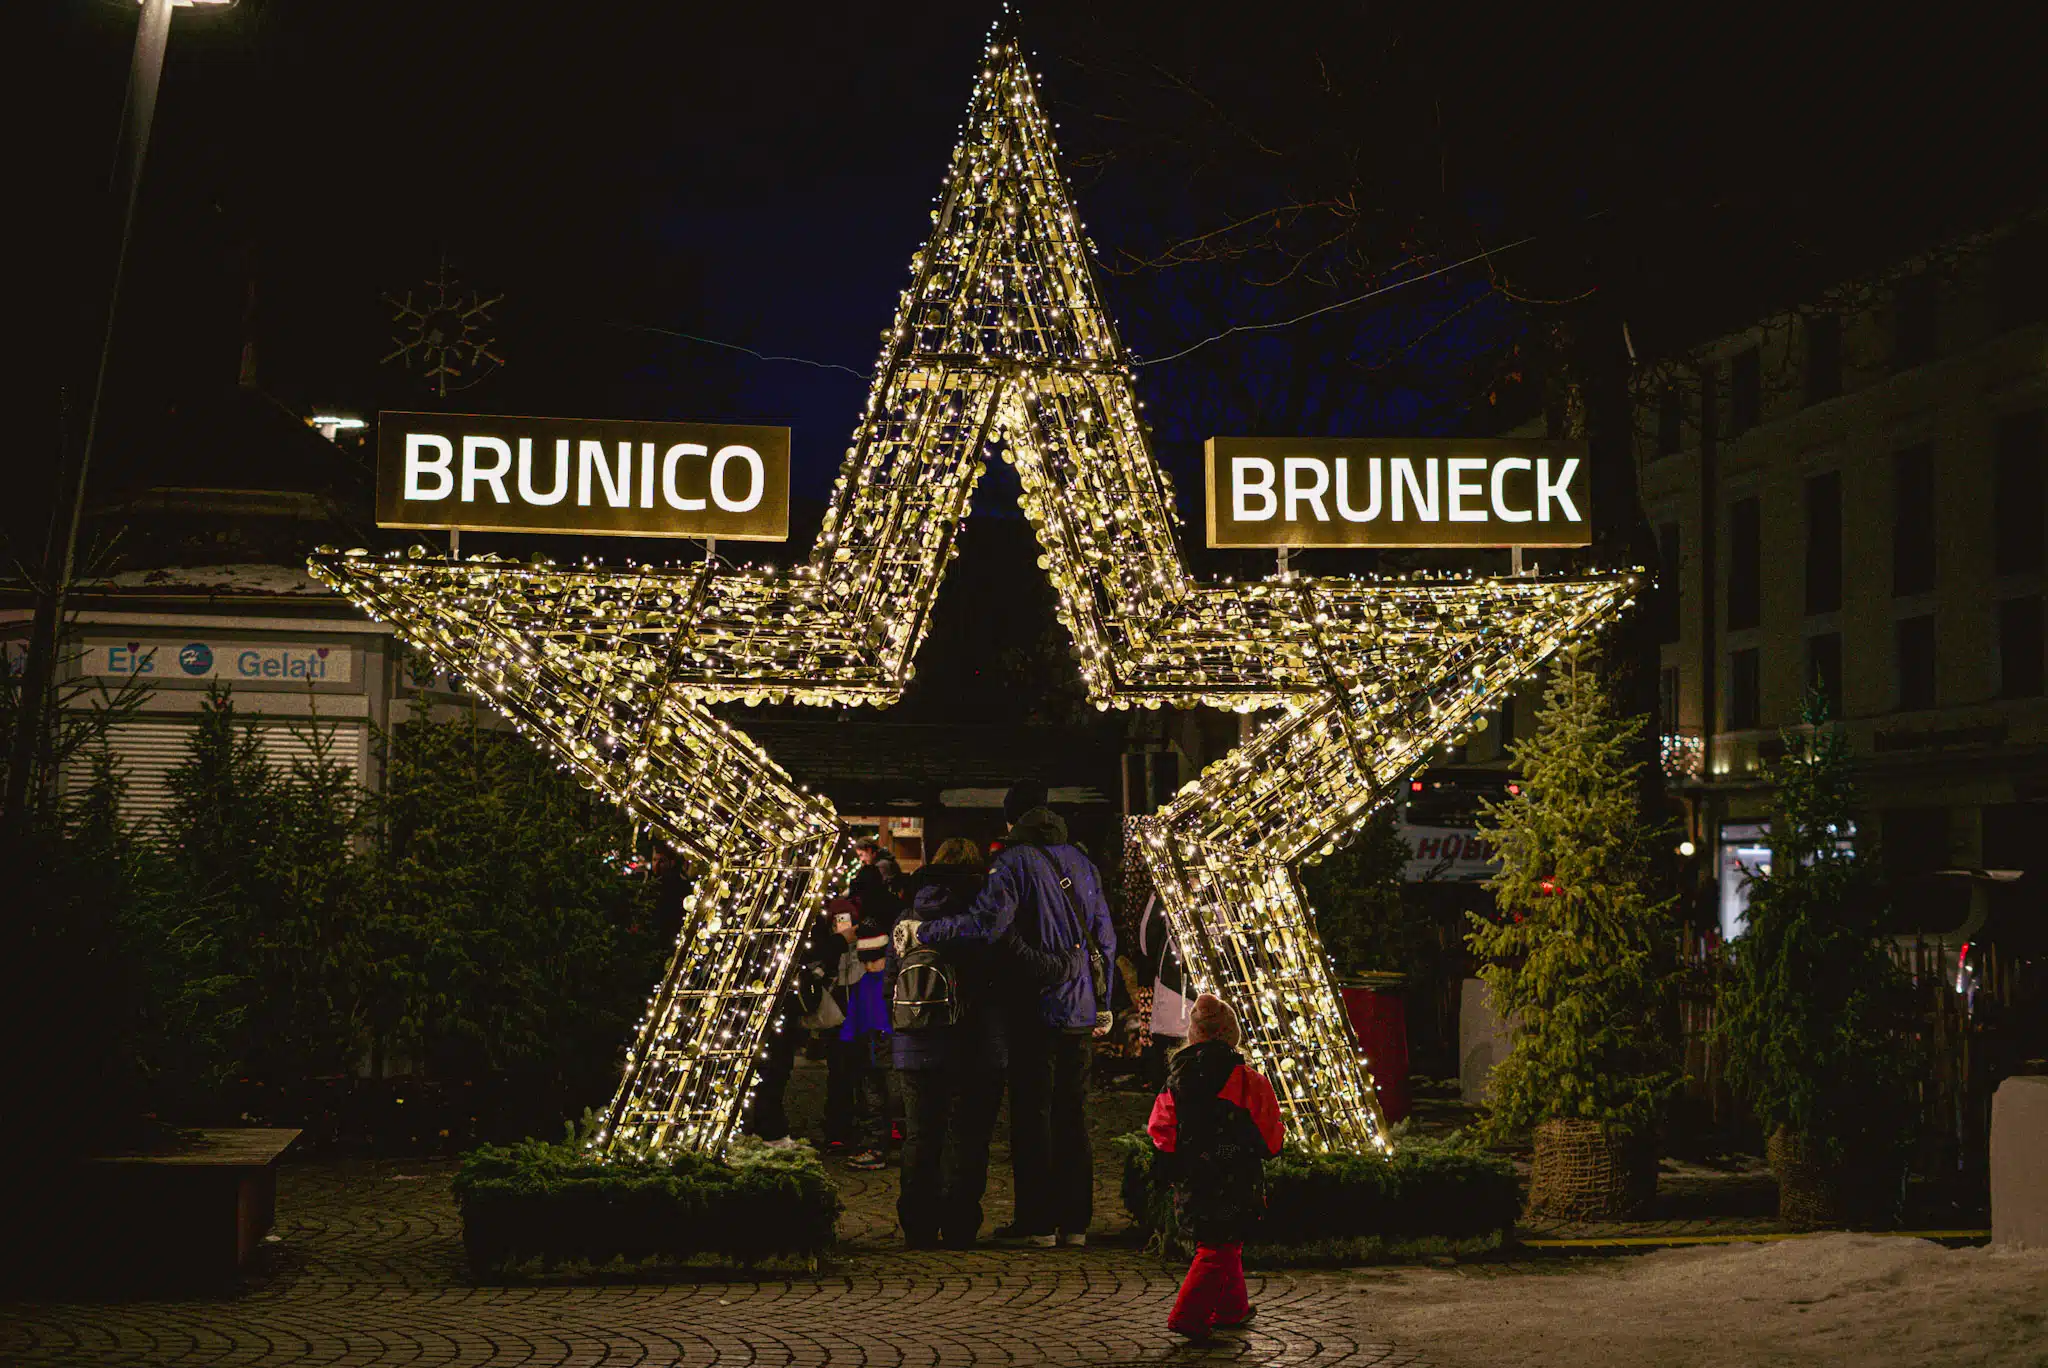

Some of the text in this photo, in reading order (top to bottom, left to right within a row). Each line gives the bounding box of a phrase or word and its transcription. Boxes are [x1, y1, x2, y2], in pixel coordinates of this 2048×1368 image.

[403, 433, 765, 513] BRUNICO
[1231, 456, 1582, 523] BRUNECK
[108, 642, 154, 673] Eis
[237, 647, 329, 679] Gelati
